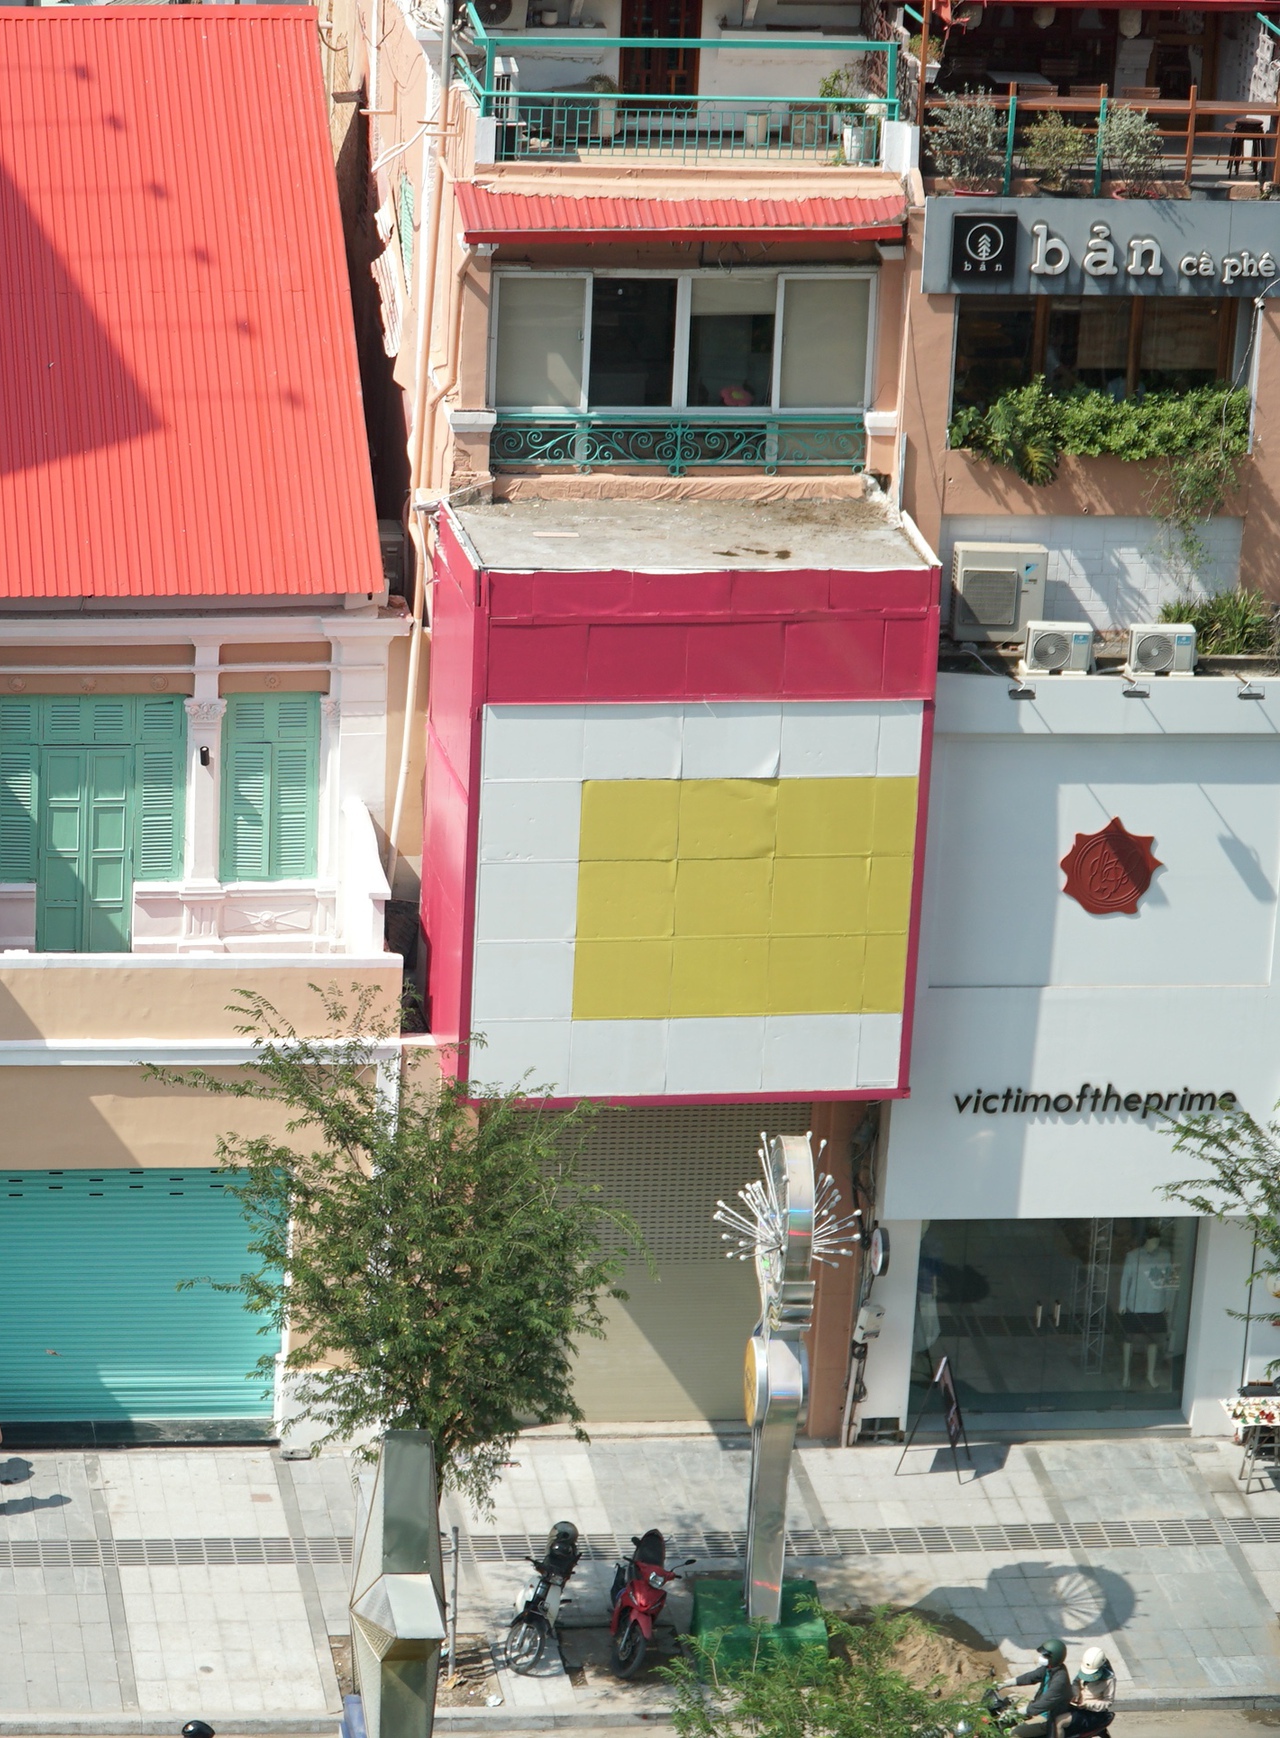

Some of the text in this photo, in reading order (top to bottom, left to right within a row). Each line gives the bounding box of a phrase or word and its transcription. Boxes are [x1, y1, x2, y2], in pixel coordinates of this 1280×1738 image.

[1031, 225, 1276, 285] bản cà phê
[954, 1082, 1237, 1119] victimoftheprime
